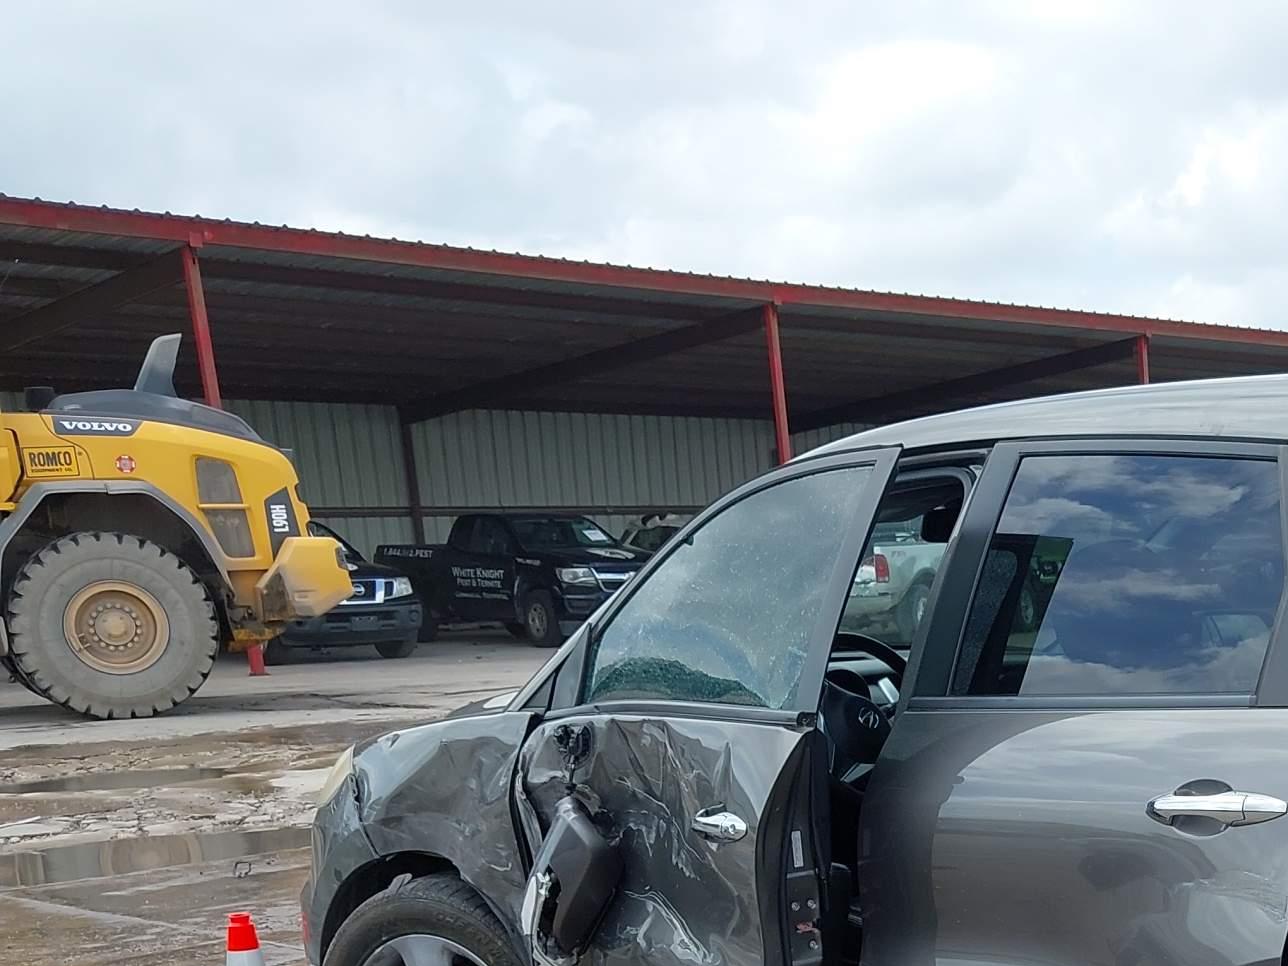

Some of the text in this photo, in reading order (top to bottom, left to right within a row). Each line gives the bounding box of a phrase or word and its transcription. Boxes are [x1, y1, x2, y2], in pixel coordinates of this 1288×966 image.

[60, 421, 132, 432] VOLVO
[29, 451, 72, 468] ROMCO
[270, 504, 290, 533] L90H
[475, 567, 505, 580] KNIGHT
